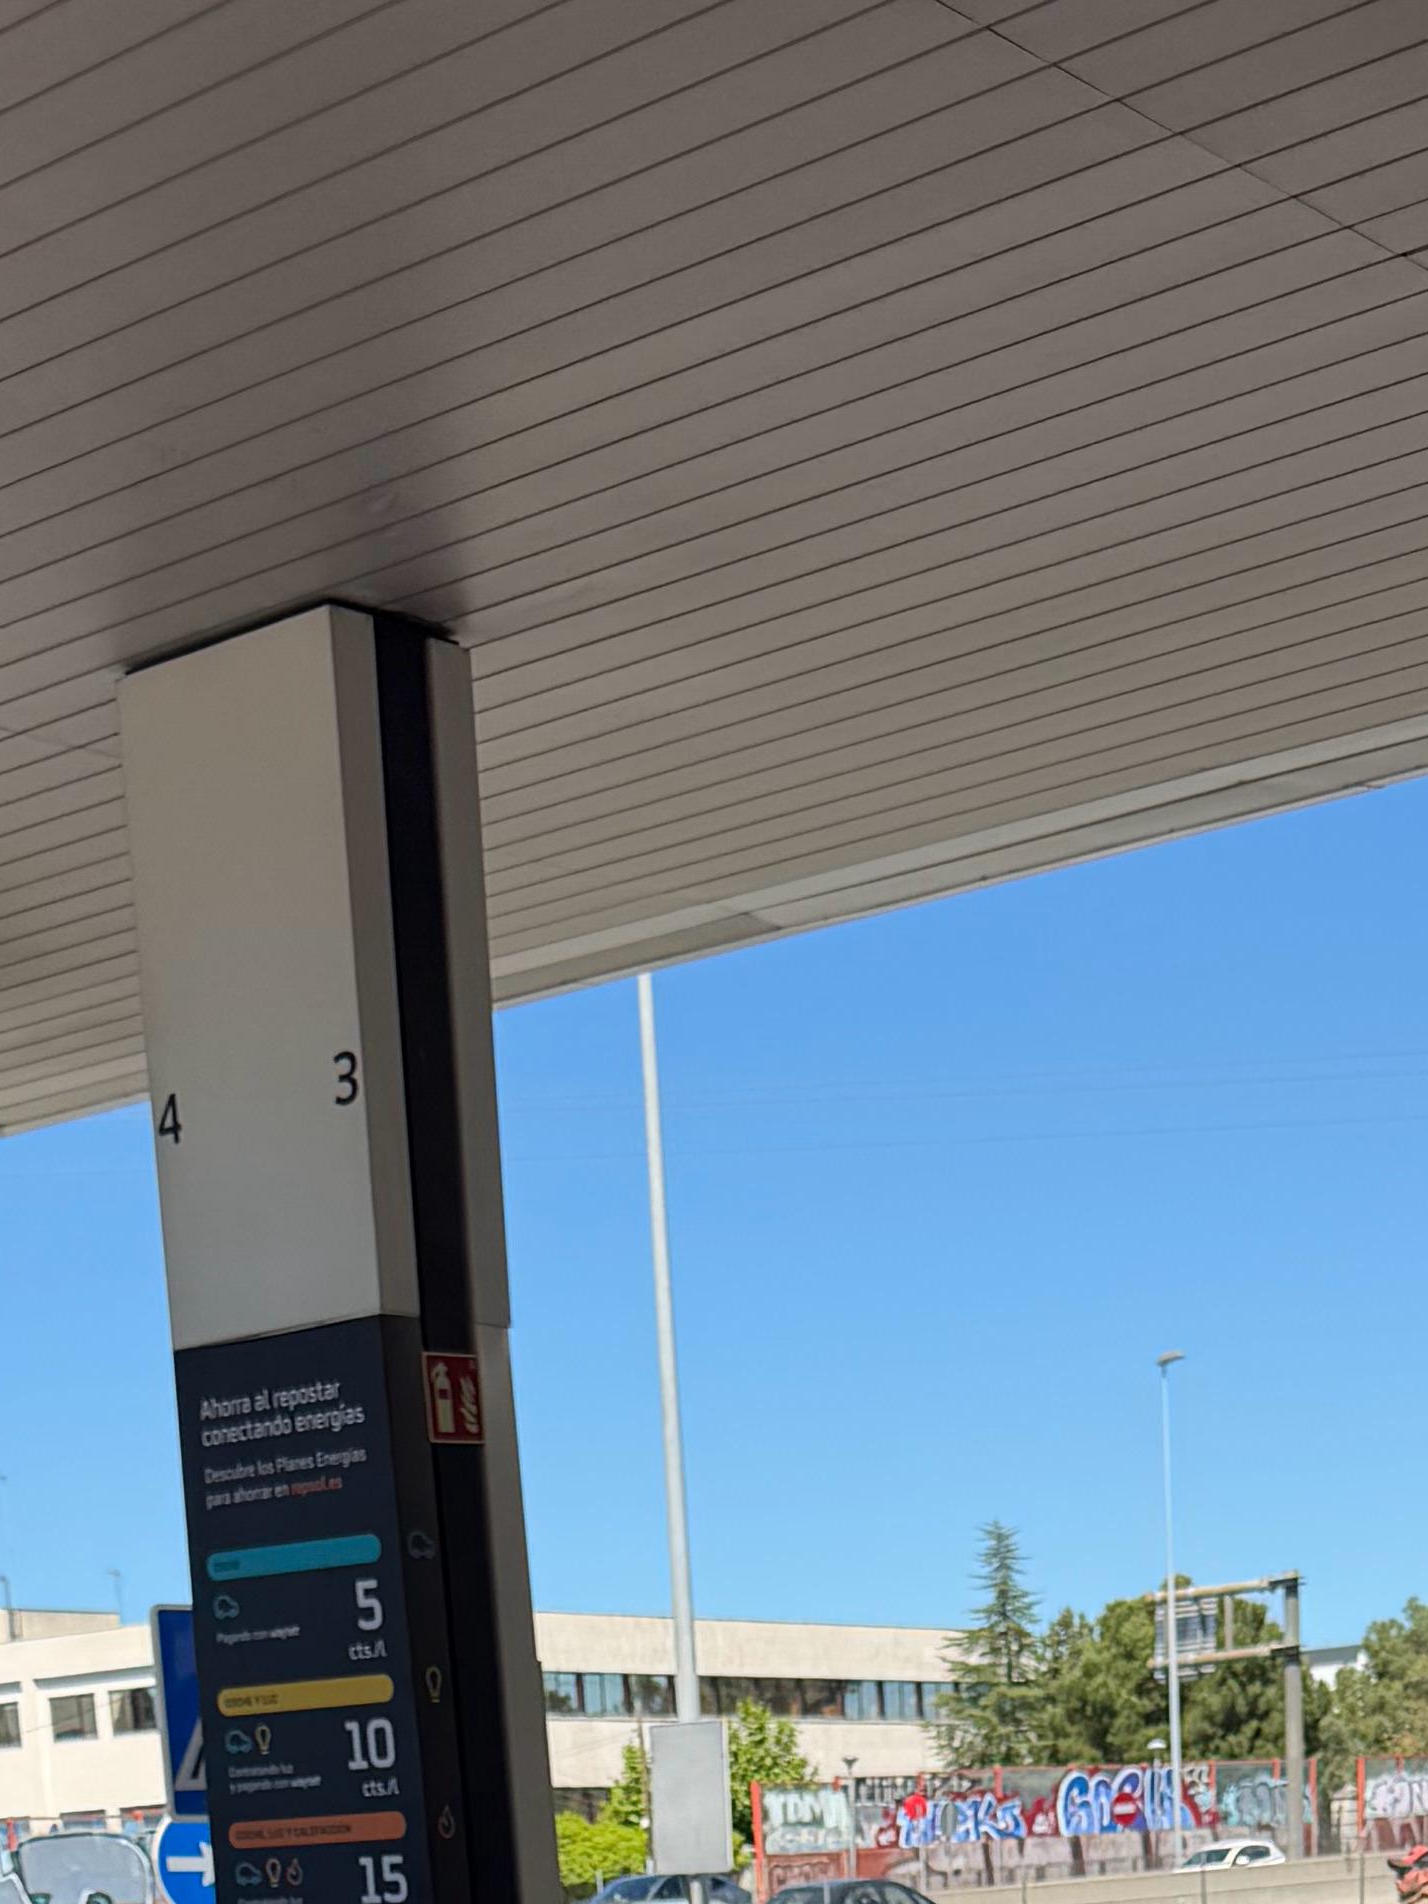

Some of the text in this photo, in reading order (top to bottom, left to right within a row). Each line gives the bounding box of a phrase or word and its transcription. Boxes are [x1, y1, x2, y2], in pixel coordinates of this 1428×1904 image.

[333, 1052, 359, 1106] 3
[158, 1093, 182, 1144] 4
[200, 1381, 340, 1421] Ahorra al repostar
[201, 1403, 365, 1447] conectando energías
[354, 1578, 383, 1632] 5
[344, 1717, 396, 1770] 10
[359, 1854, 408, 1904] 15
